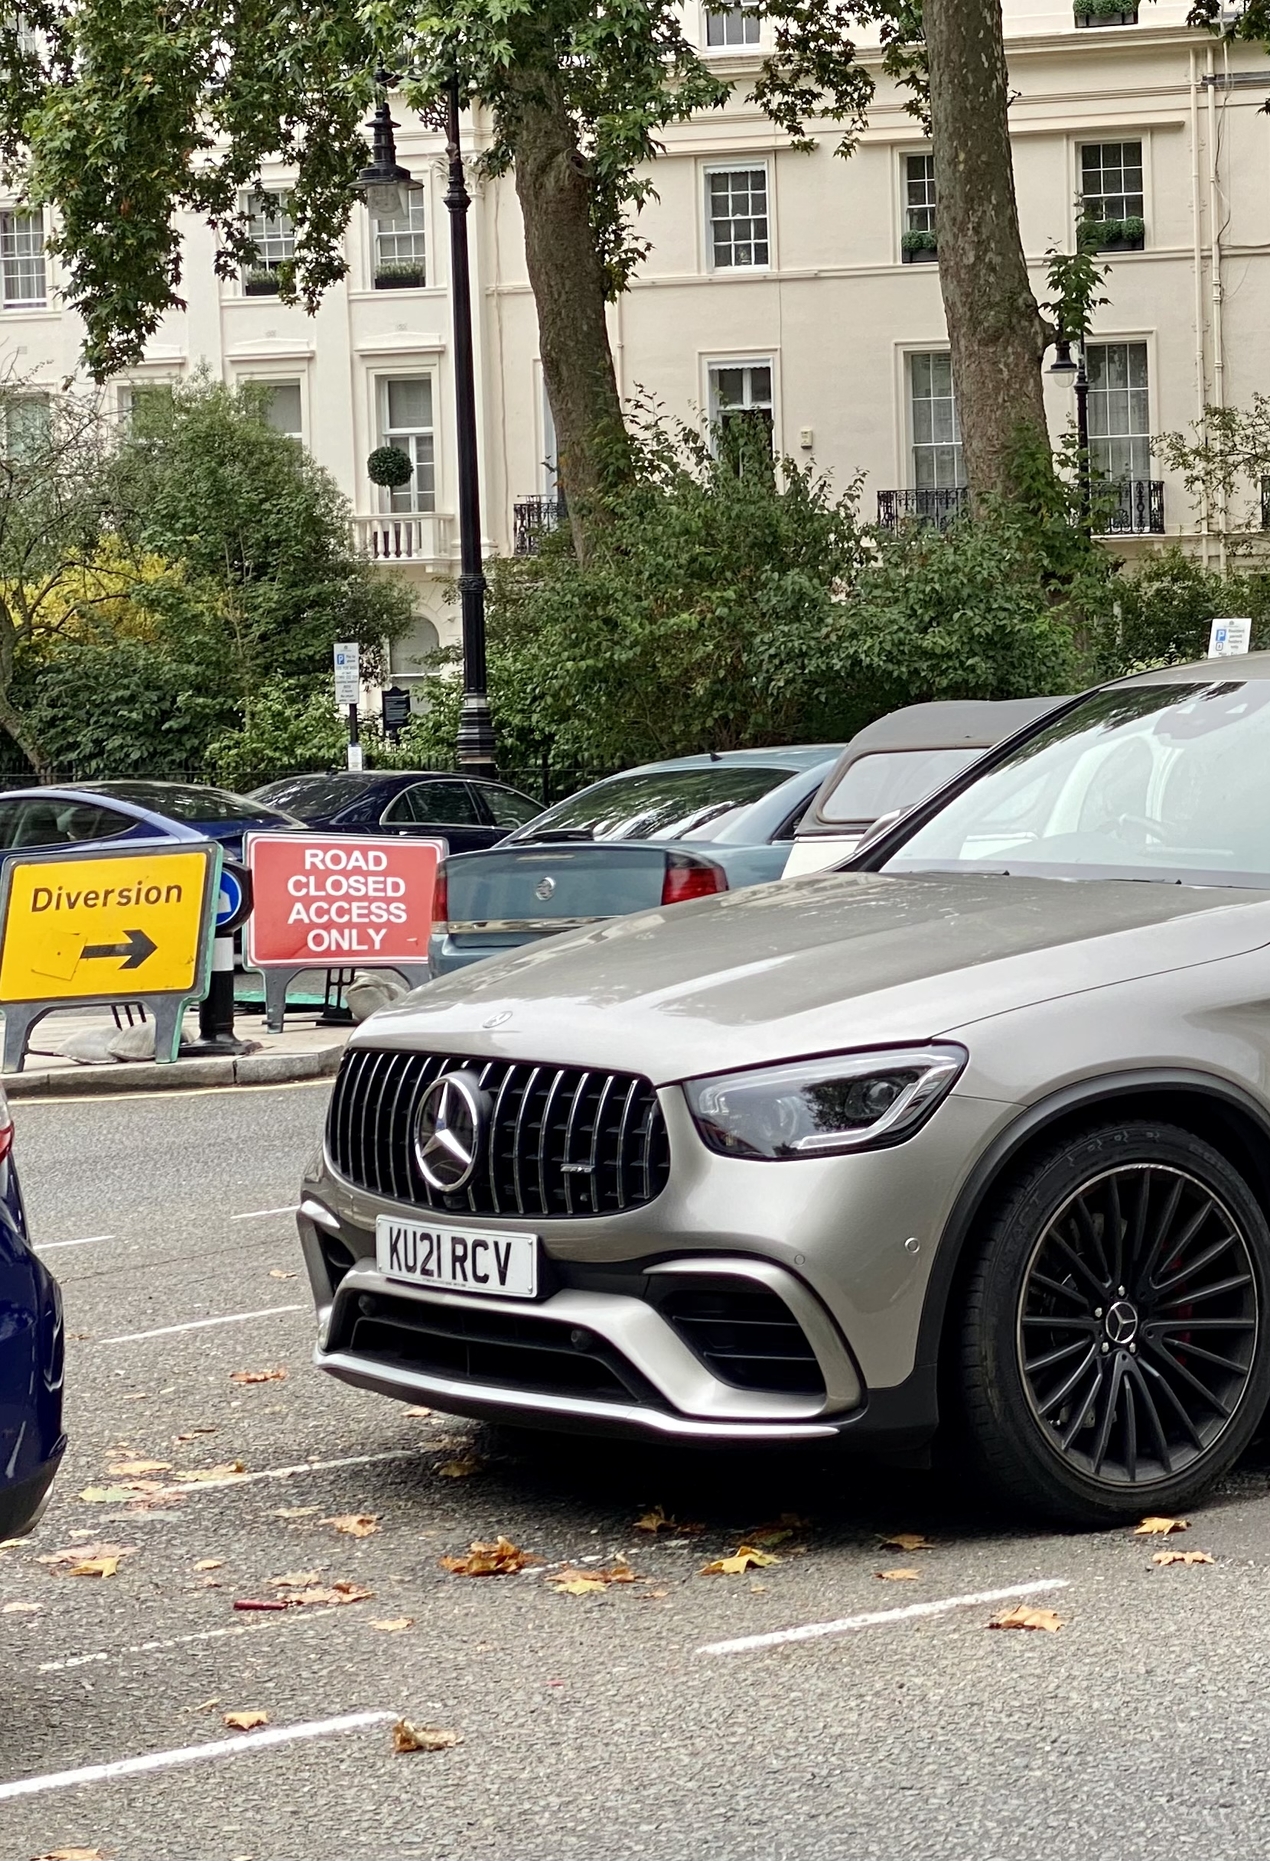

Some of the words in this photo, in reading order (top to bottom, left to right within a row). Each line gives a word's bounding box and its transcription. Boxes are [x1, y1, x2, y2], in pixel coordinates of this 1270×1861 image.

[304, 849, 388, 871] ROAD
[31, 880, 183, 912] Diversion
[287, 875, 406, 897] CLOSED
[287, 901, 408, 925] ACCESS
[306, 928, 388, 952] ONLY
[389, 1227, 442, 1278] KU21
[451, 1236, 512, 1286] RCV
